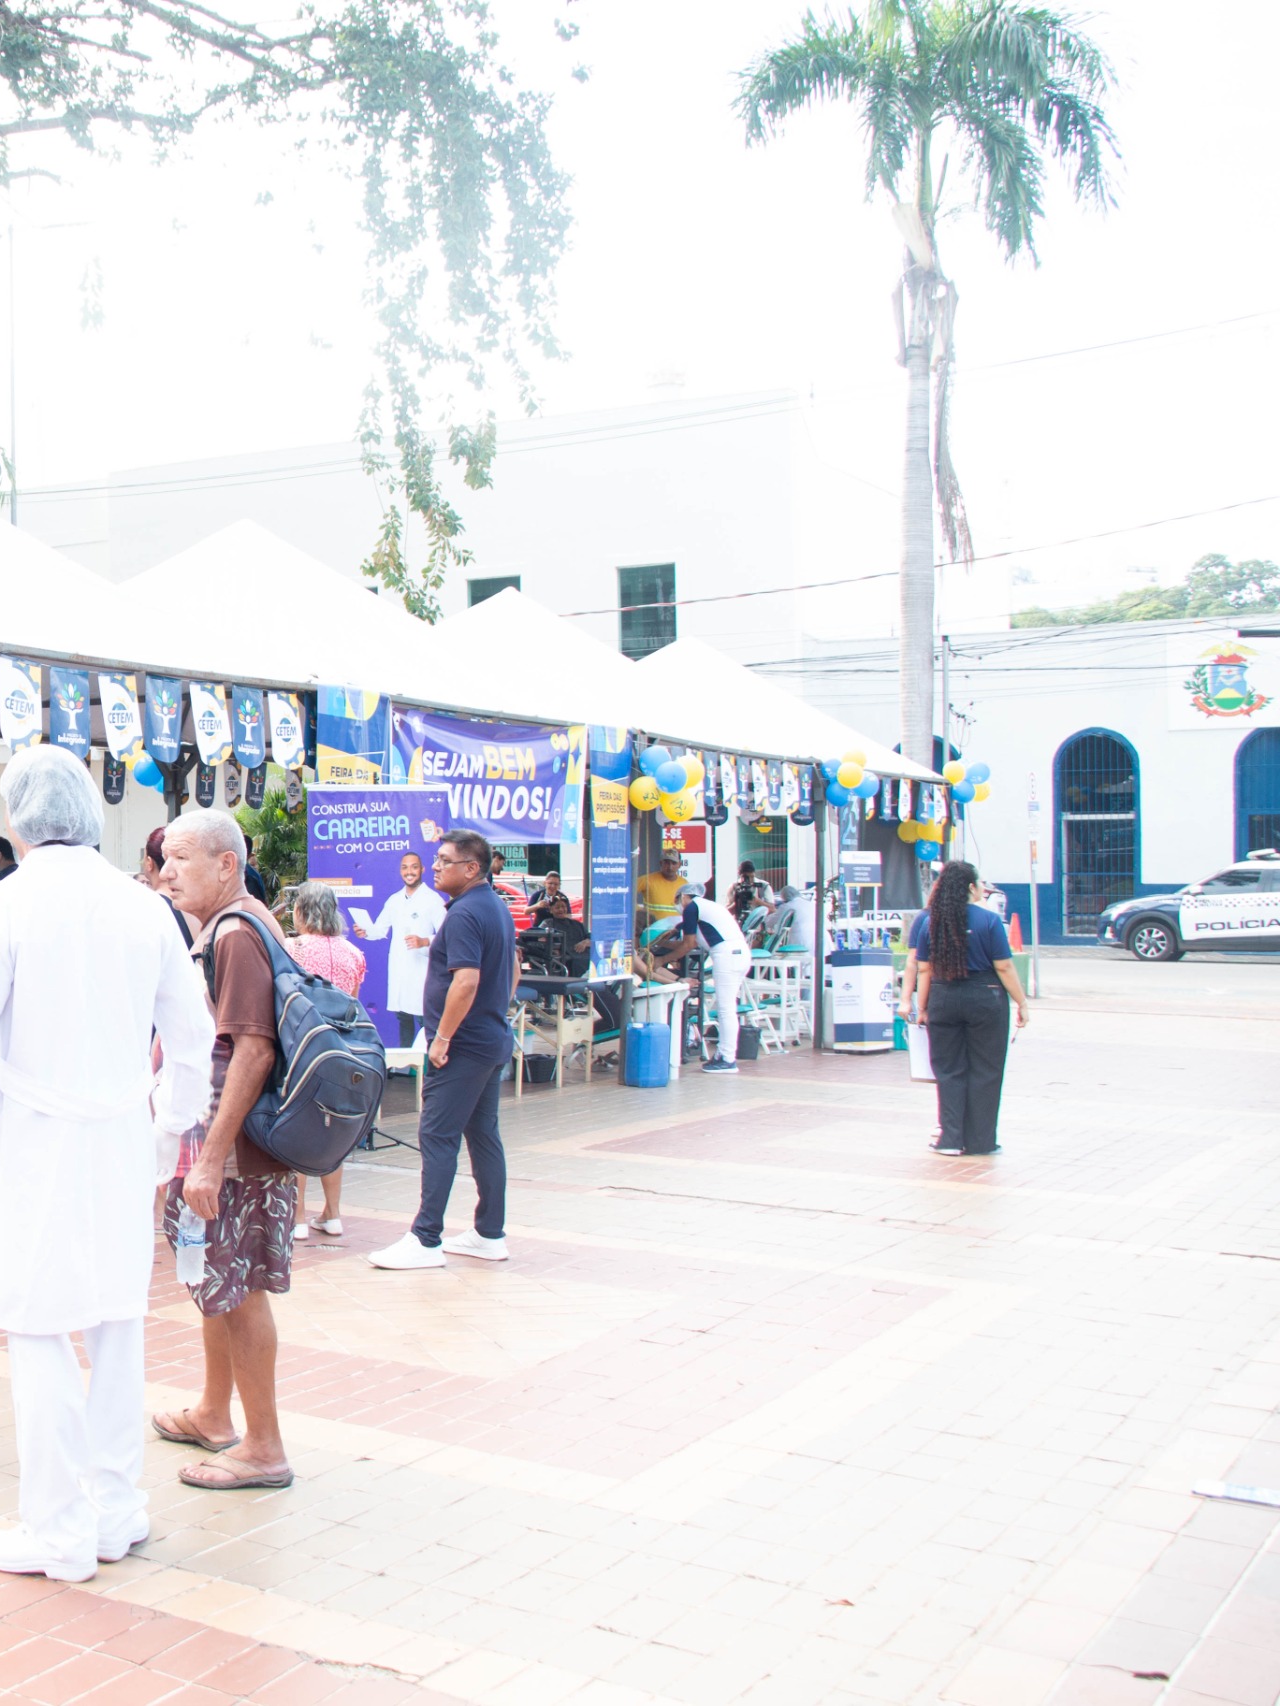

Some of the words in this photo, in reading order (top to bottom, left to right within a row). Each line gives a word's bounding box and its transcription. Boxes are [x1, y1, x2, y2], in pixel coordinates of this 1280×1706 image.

[4, 696, 35, 716] CETEM
[107, 711, 134, 725] CETEM
[197, 718, 223, 731] CETEM
[275, 725, 298, 737] CETEM
[422, 750, 485, 779] SEJAM
[483, 745, 536, 781] BEM
[330, 766, 353, 778] FEIRA
[311, 802, 369, 816] CONSTRUA
[370, 801, 391, 813] SUA
[447, 783, 552, 820] VINDOS!
[313, 815, 410, 841] CARREIRA
[662, 828, 682, 839] E-SE
[336, 843, 362, 854] COM
[364, 842, 374, 852] O
[376, 839, 410, 851] CETEM
[662, 839, 686, 850] GA-SE
[335, 886, 361, 895] mácia
[866, 912, 903, 921] ICIA
[1195, 917, 1280, 931] POLÍCIA
